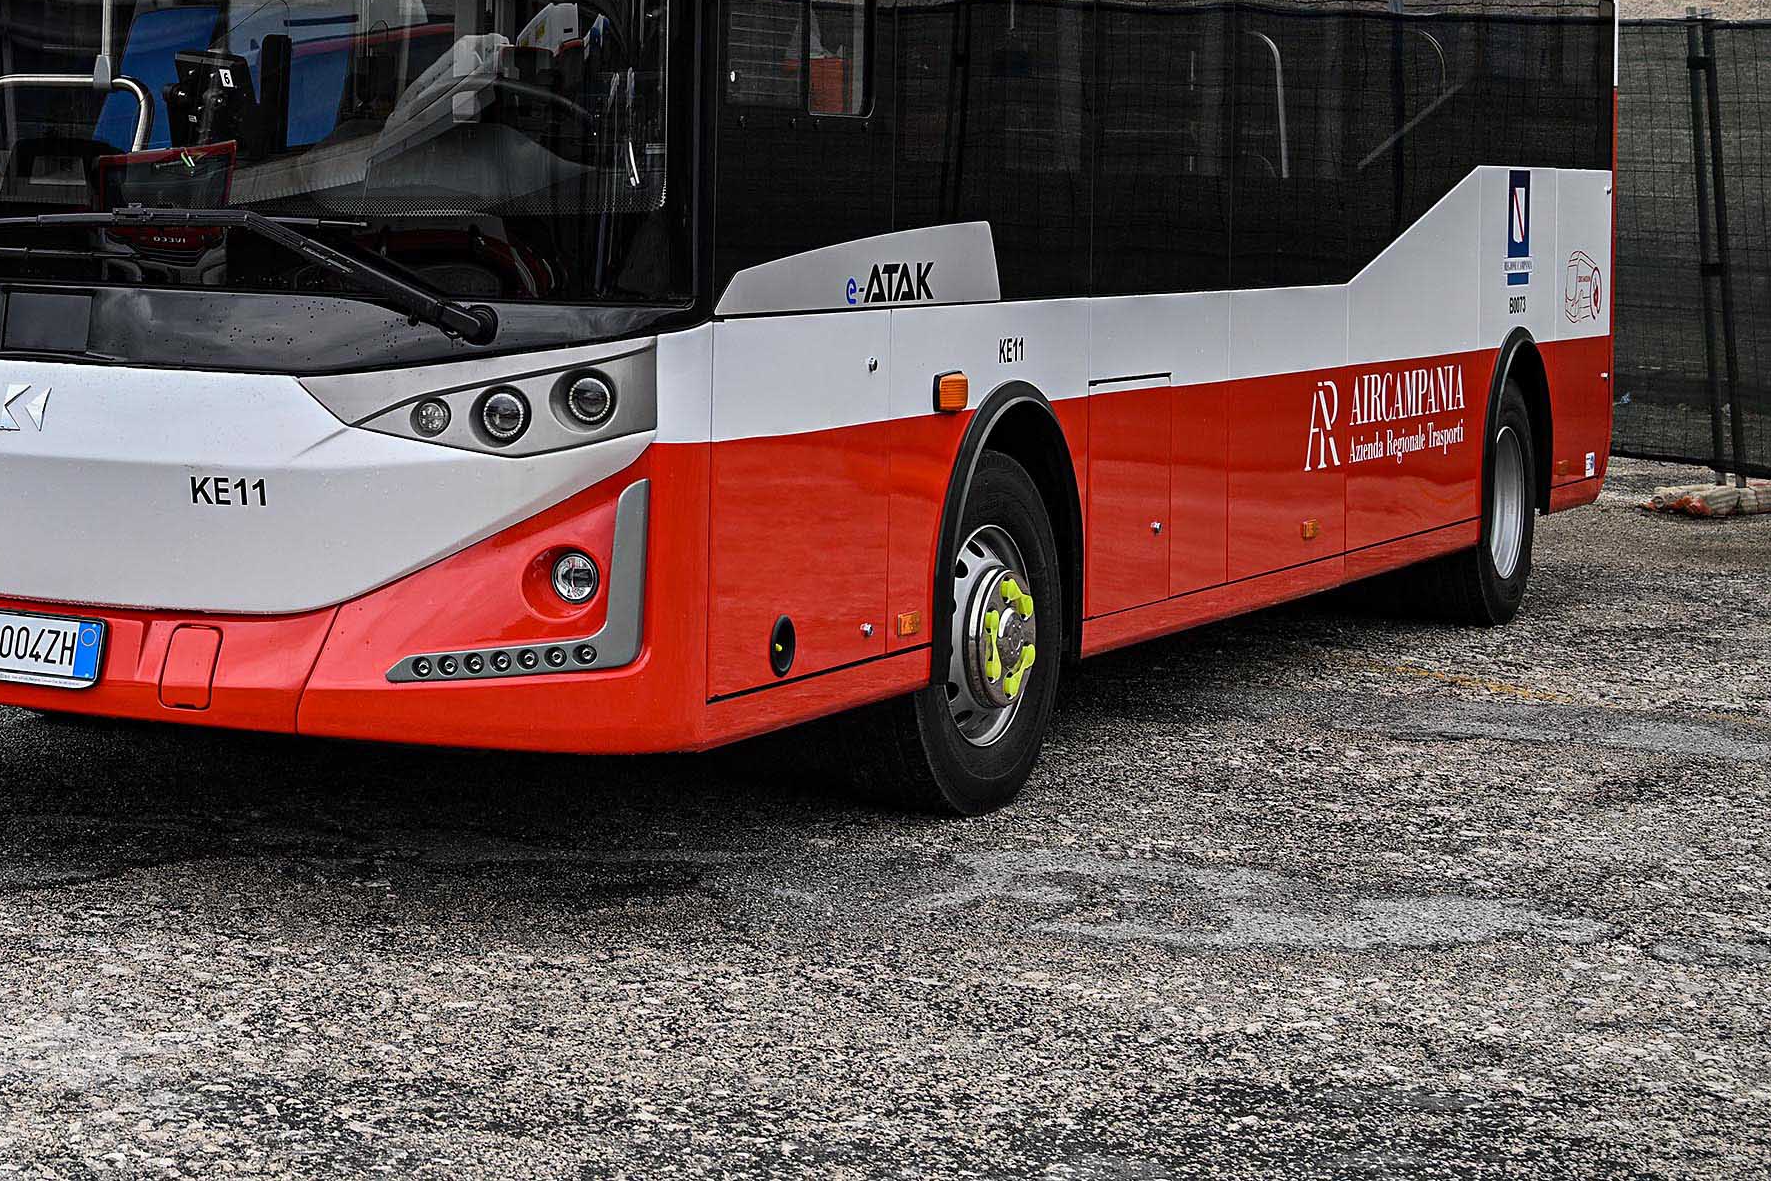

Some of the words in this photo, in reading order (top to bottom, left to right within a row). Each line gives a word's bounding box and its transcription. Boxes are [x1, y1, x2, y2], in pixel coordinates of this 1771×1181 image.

[845, 261, 935, 305] e-ATAK
[1509, 295, 1527, 315] B0073
[998, 336, 1024, 364] KE11
[1348, 364, 1466, 426] AIRCAMPANIA
[1348, 431, 1384, 464] Azienda
[1386, 424, 1426, 464] Regionale
[1427, 419, 1464, 455] Trasporti
[190, 476, 268, 507] KE11
